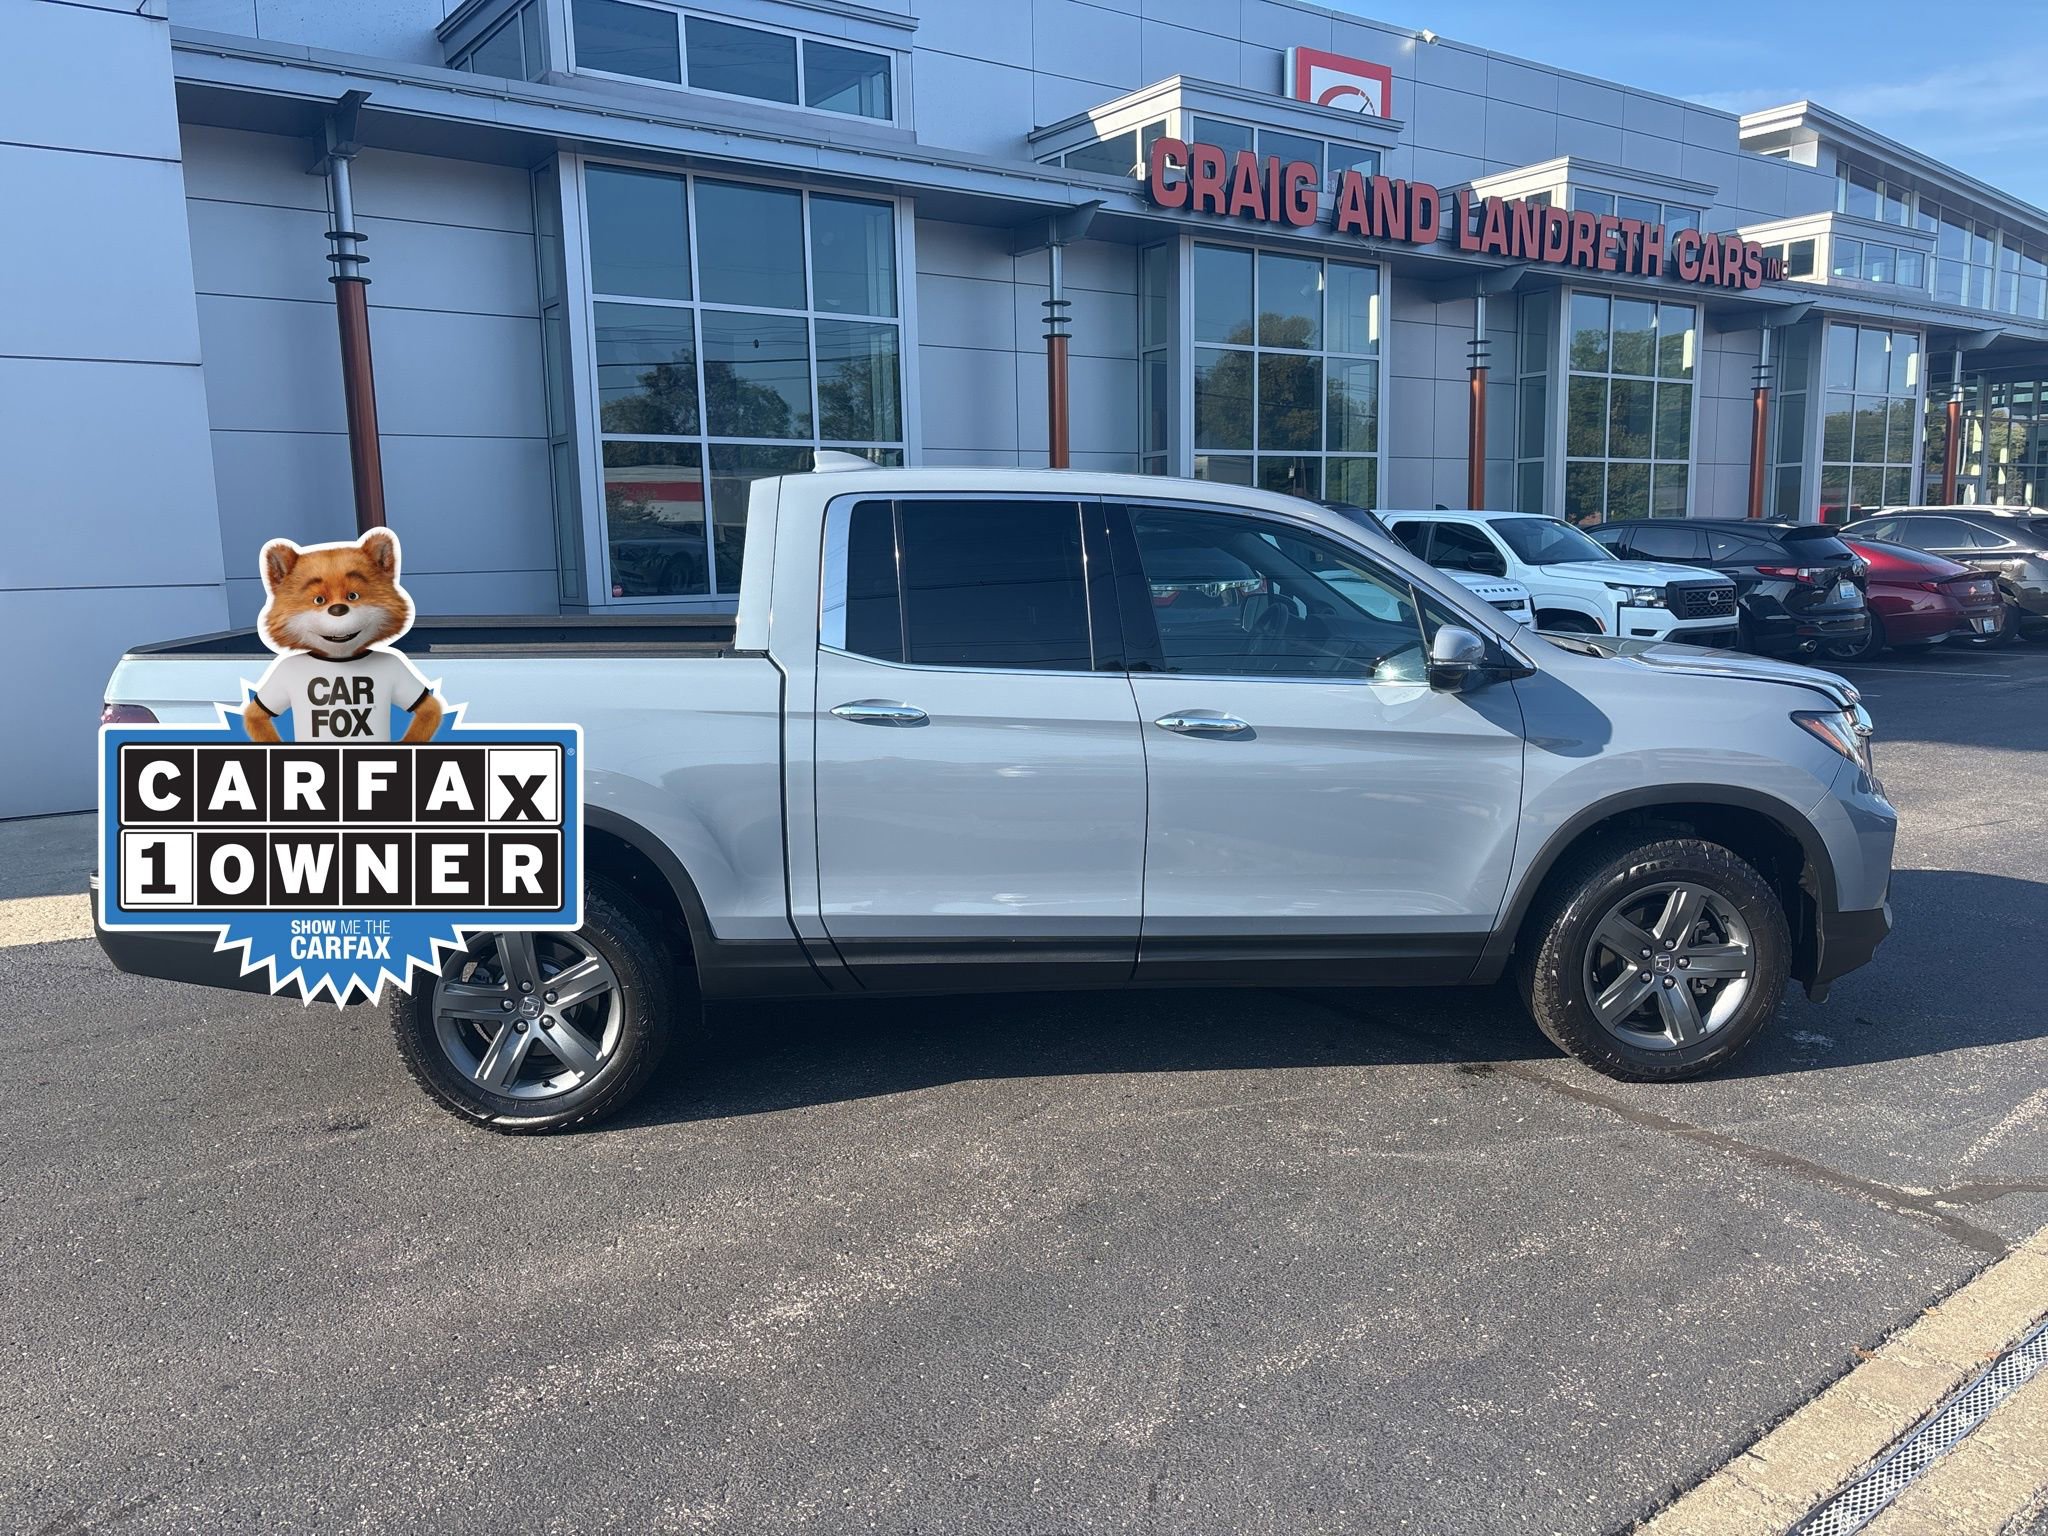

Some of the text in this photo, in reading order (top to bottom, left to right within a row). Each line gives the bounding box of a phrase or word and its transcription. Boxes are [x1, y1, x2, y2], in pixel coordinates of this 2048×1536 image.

[1152, 137, 1318, 227] CRAIG
[1338, 170, 1440, 244] AND
[1459, 189, 1665, 277] LANDRETH
[1678, 228, 1763, 290] CARS
